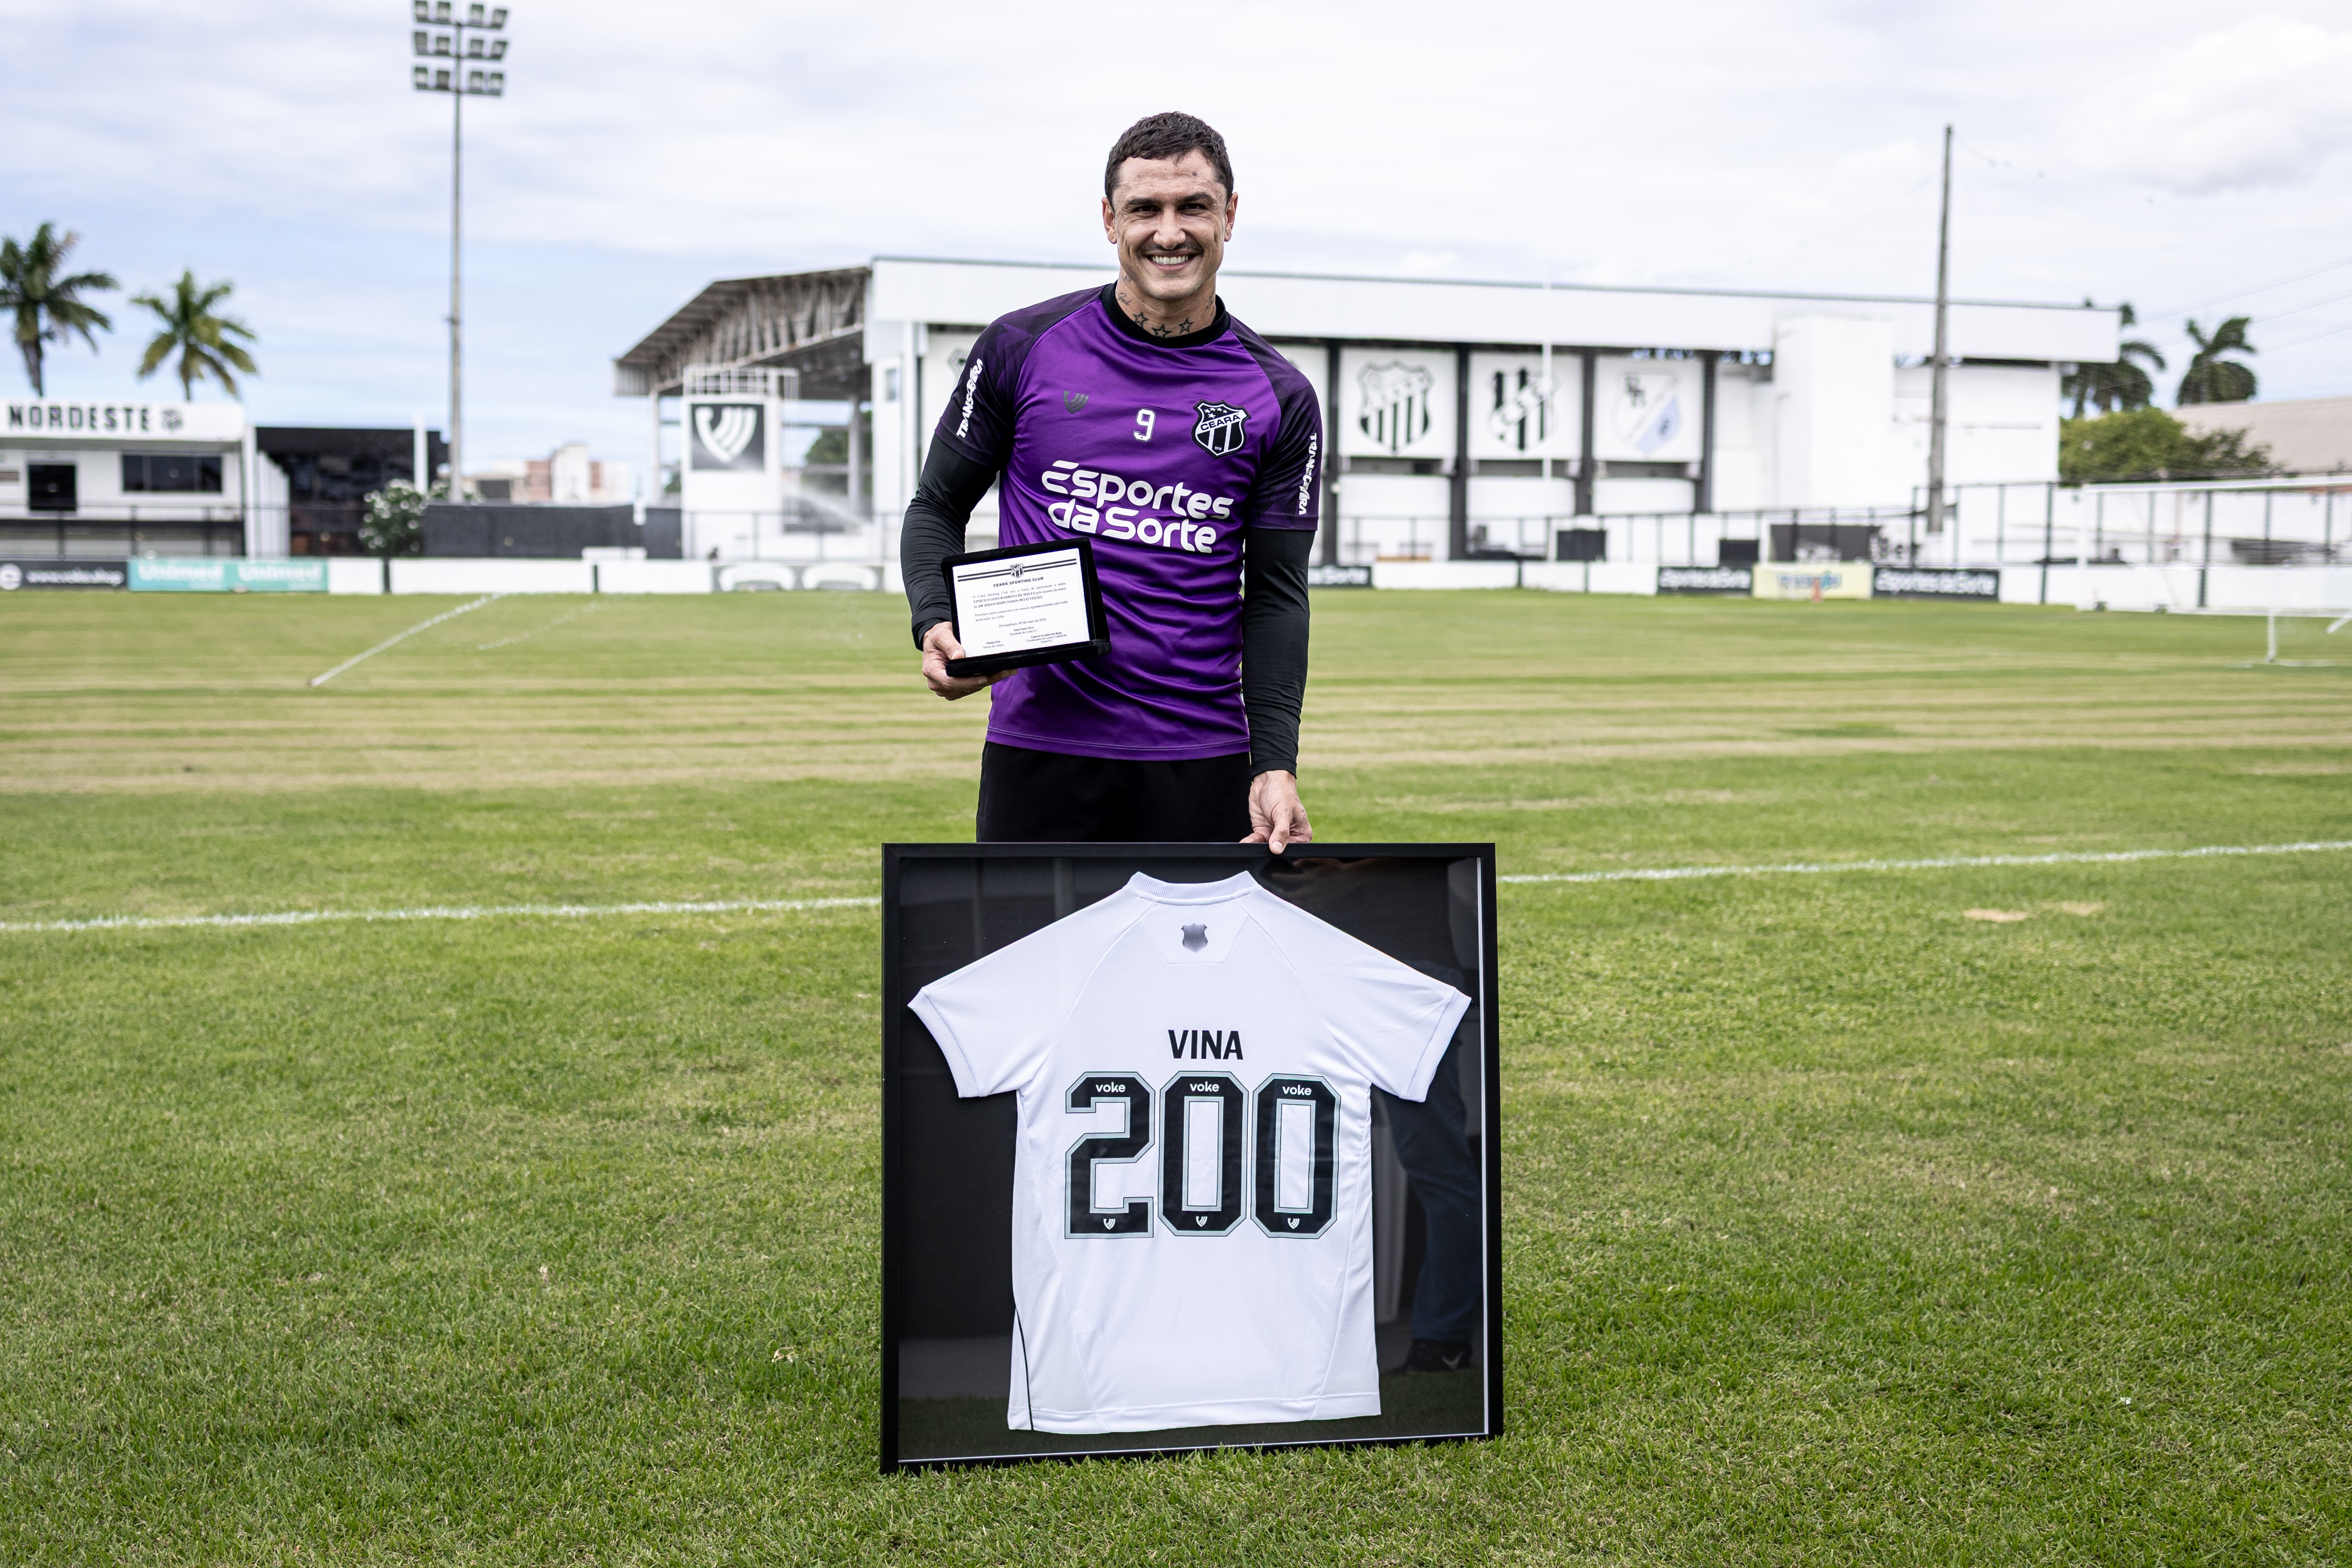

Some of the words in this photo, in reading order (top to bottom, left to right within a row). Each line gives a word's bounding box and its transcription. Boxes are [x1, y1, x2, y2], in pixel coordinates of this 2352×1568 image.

[9, 405, 149, 430] NORDESTE
[1133, 408, 1156, 442] 9
[1201, 413, 1241, 431] CEARÁ
[1041, 460, 1234, 519] Esportes
[1168, 1029, 1243, 1060] VINA
[1096, 1082, 1126, 1093] voke
[1189, 1081, 1219, 1092] voke
[1282, 1085, 1312, 1096] voke
[1065, 1071, 1341, 1239] 200
